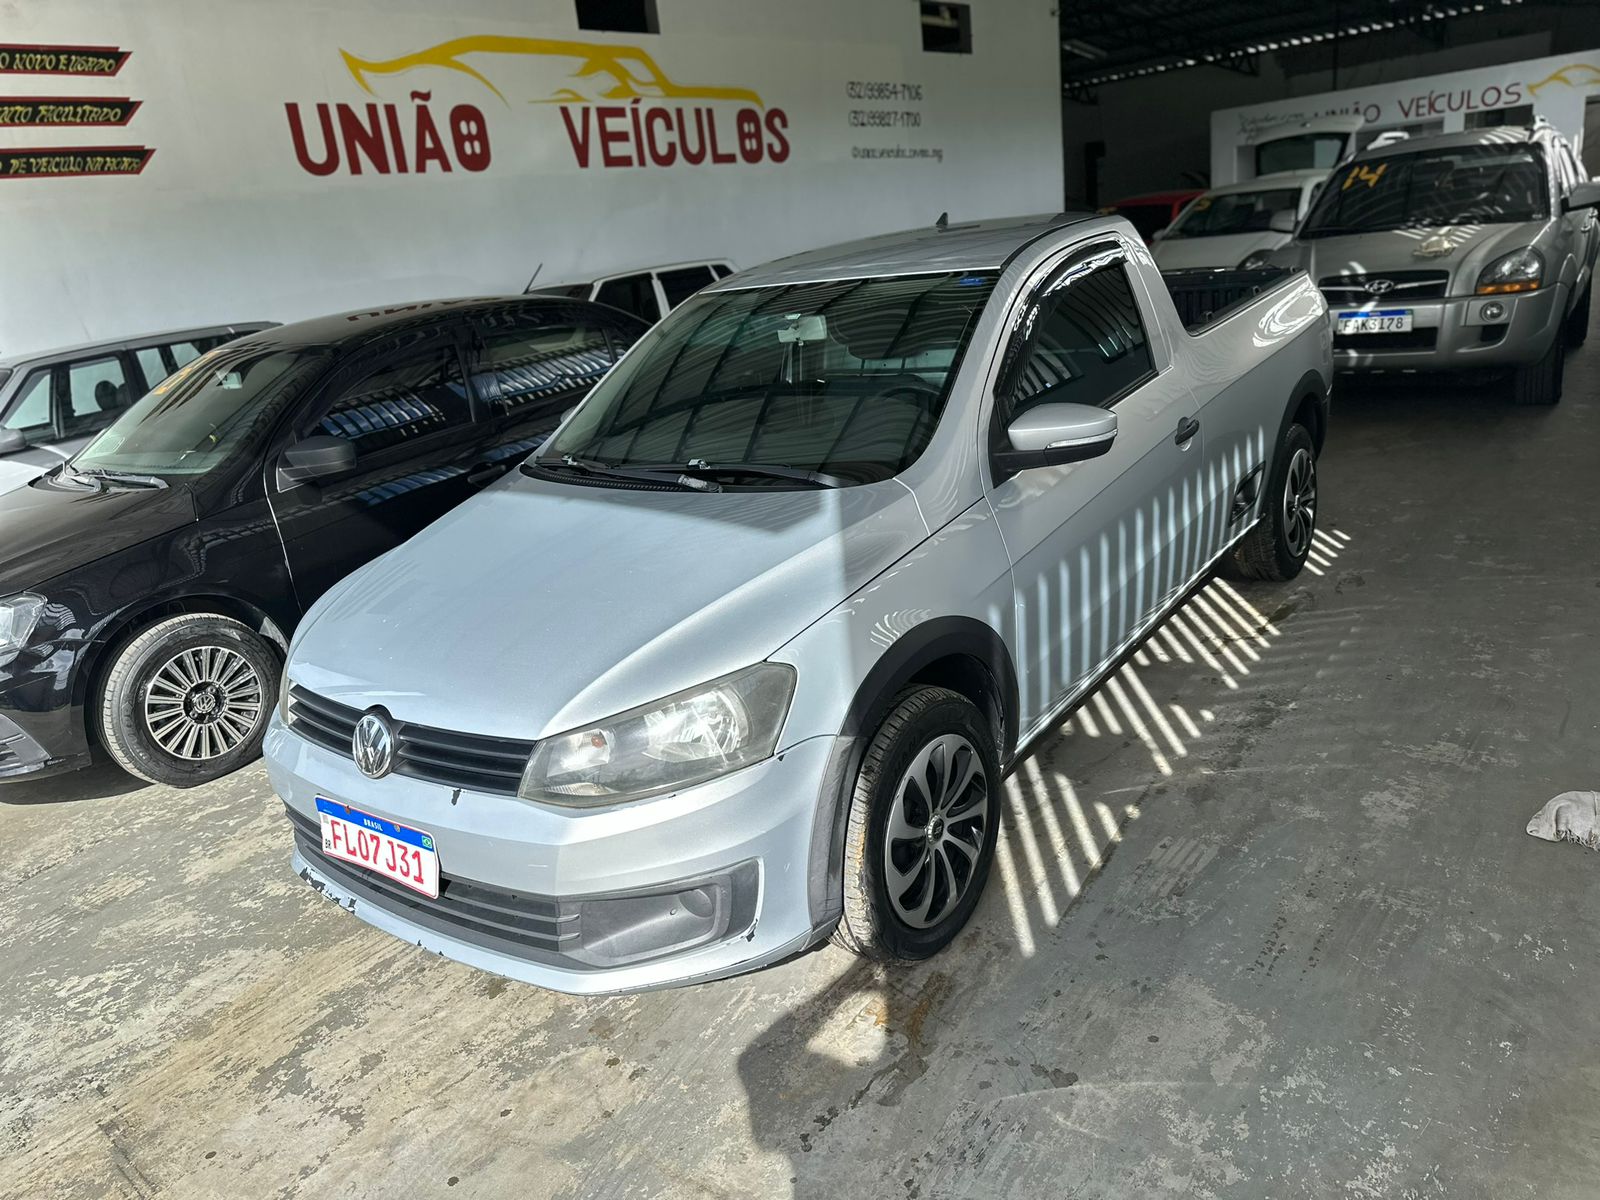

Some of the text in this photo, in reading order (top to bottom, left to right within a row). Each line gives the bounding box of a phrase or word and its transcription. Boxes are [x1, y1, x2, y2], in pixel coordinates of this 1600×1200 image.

[13, 53, 56, 70] NOVO
[58, 54, 69, 70] E
[69, 55, 116, 72] USADO
[1397, 82, 1522, 119] VEÍCULOS
[35, 105, 122, 123] FACILITADO
[285, 90, 790, 176] UNIÃO VEÍCULOS
[10, 158, 28, 174] DE
[29, 156, 84, 173] VEICULO
[85, 156, 104, 172] NA
[1342, 163, 1388, 190] 14
[363, 818, 384, 832] BRASIL
